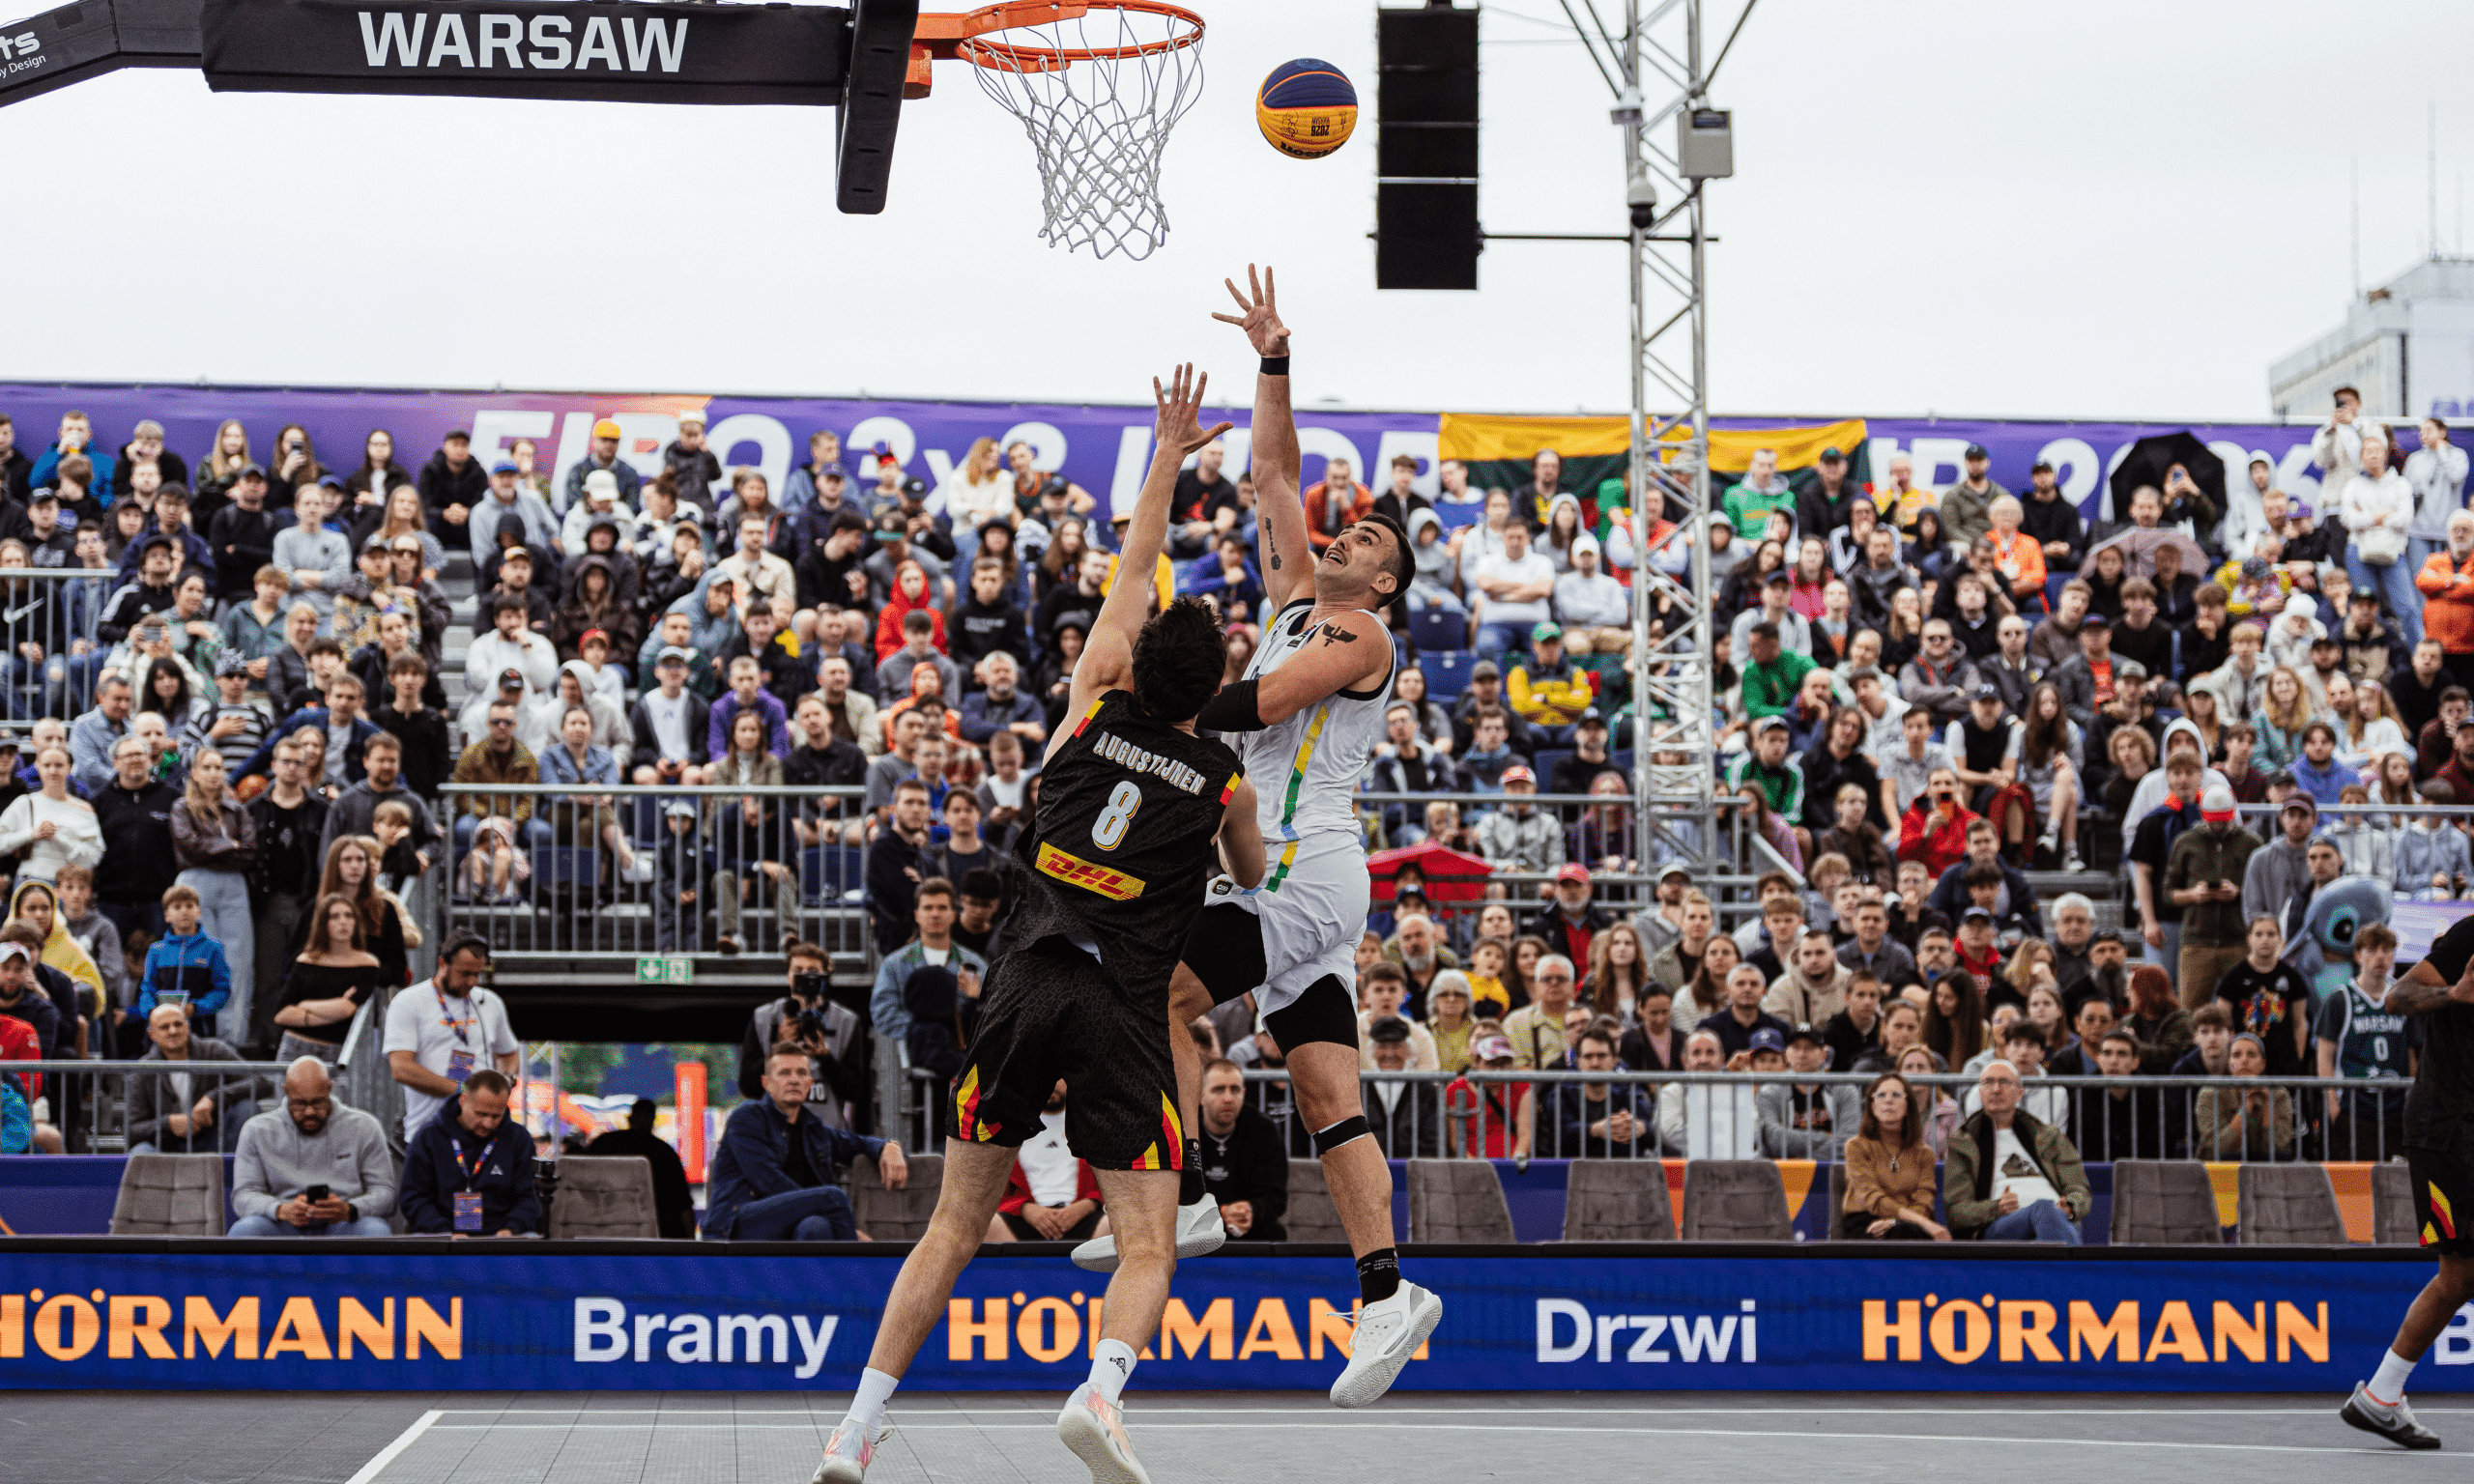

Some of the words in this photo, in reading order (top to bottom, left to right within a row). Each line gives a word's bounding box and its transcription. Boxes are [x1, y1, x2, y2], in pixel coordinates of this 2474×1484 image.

[8, 55, 46, 73] Design
[358, 12, 689, 72] WARSAW
[1092, 731, 1207, 795] AUGUSTIJNEN
[1091, 780, 1142, 851] 8
[1046, 852, 1125, 897] DHL
[2373, 1036, 2389, 1062] 0
[573, 1296, 839, 1379] Bramy
[948, 1290, 1429, 1363] HÖMAN
[1535, 1297, 1757, 1363] Drzwi
[1860, 1292, 2330, 1365] HÖRMANN
